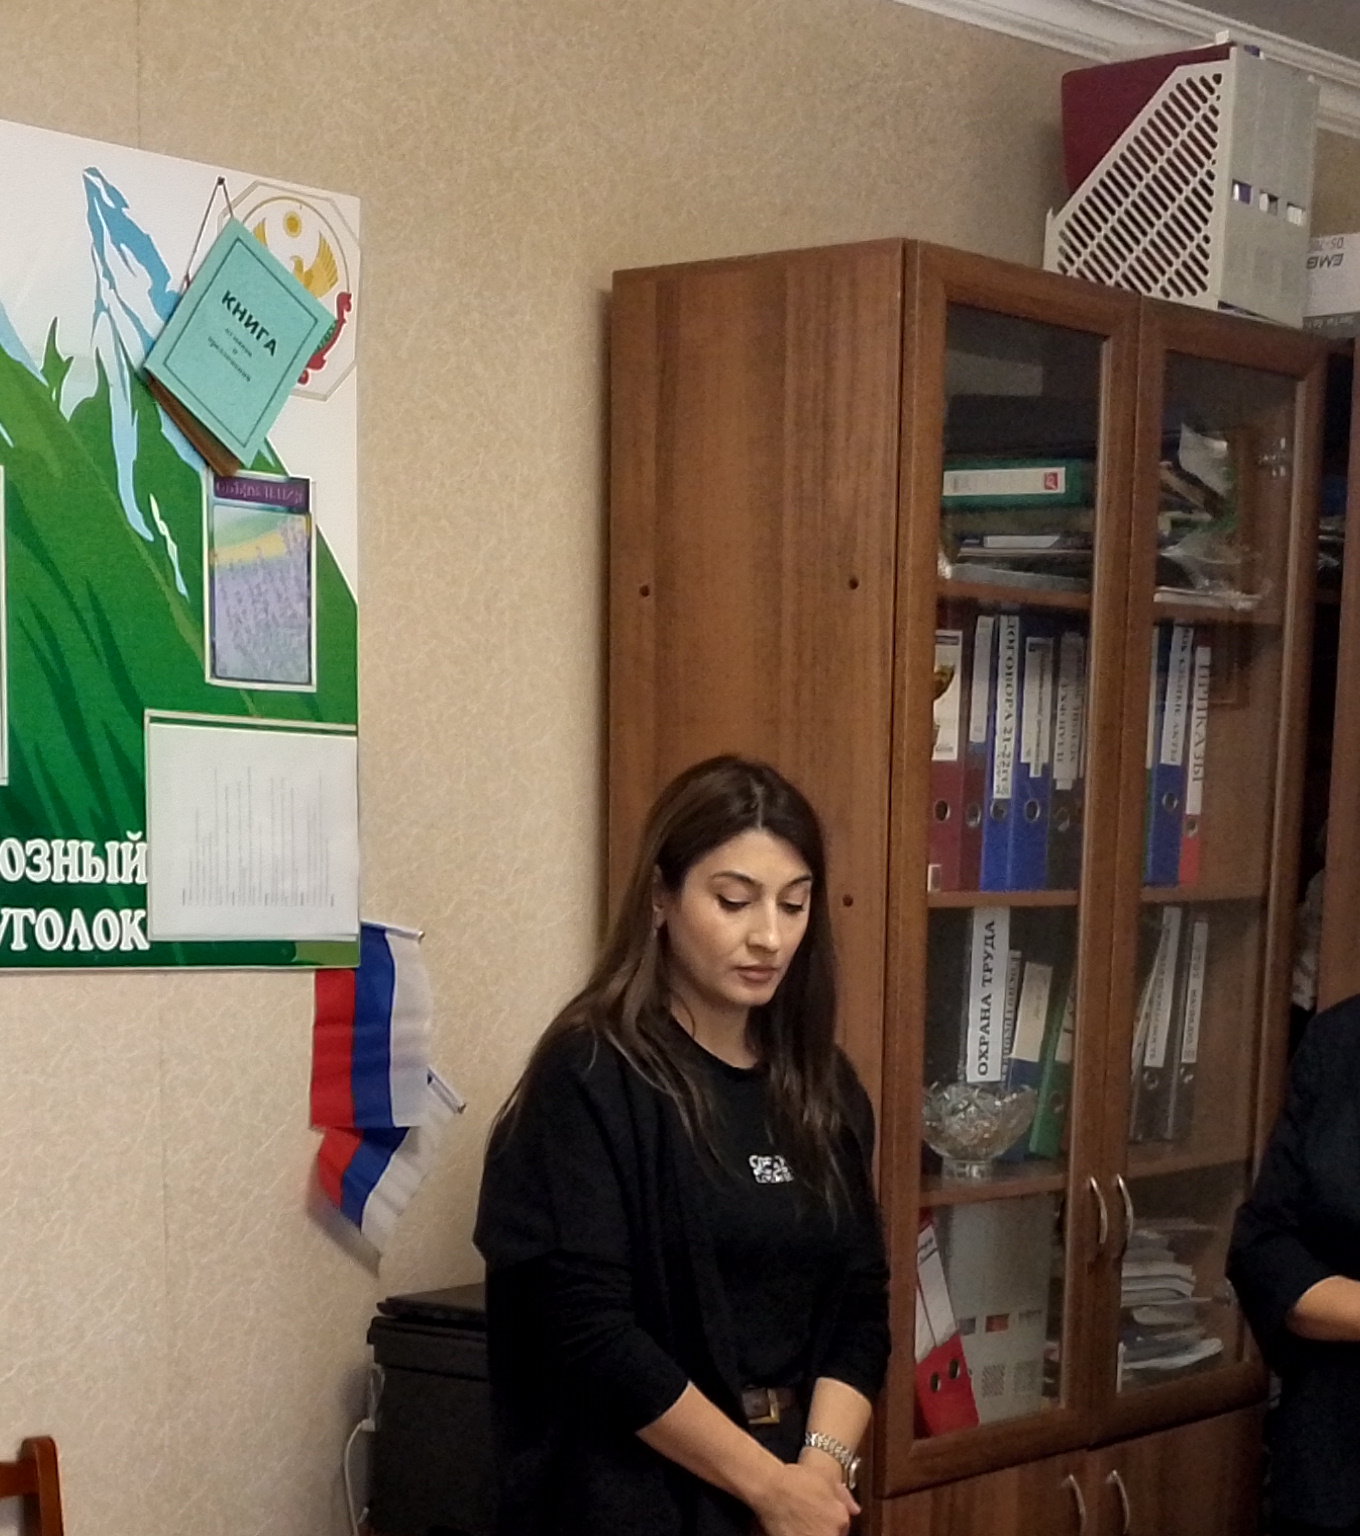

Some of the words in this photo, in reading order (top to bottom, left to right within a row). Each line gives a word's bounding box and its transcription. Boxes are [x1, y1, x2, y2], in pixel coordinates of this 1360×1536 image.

[221, 289, 277, 357] КНИГА
[981, 920, 996, 988] ТРУДА
[978, 993, 992, 1076] ОХРАНА
